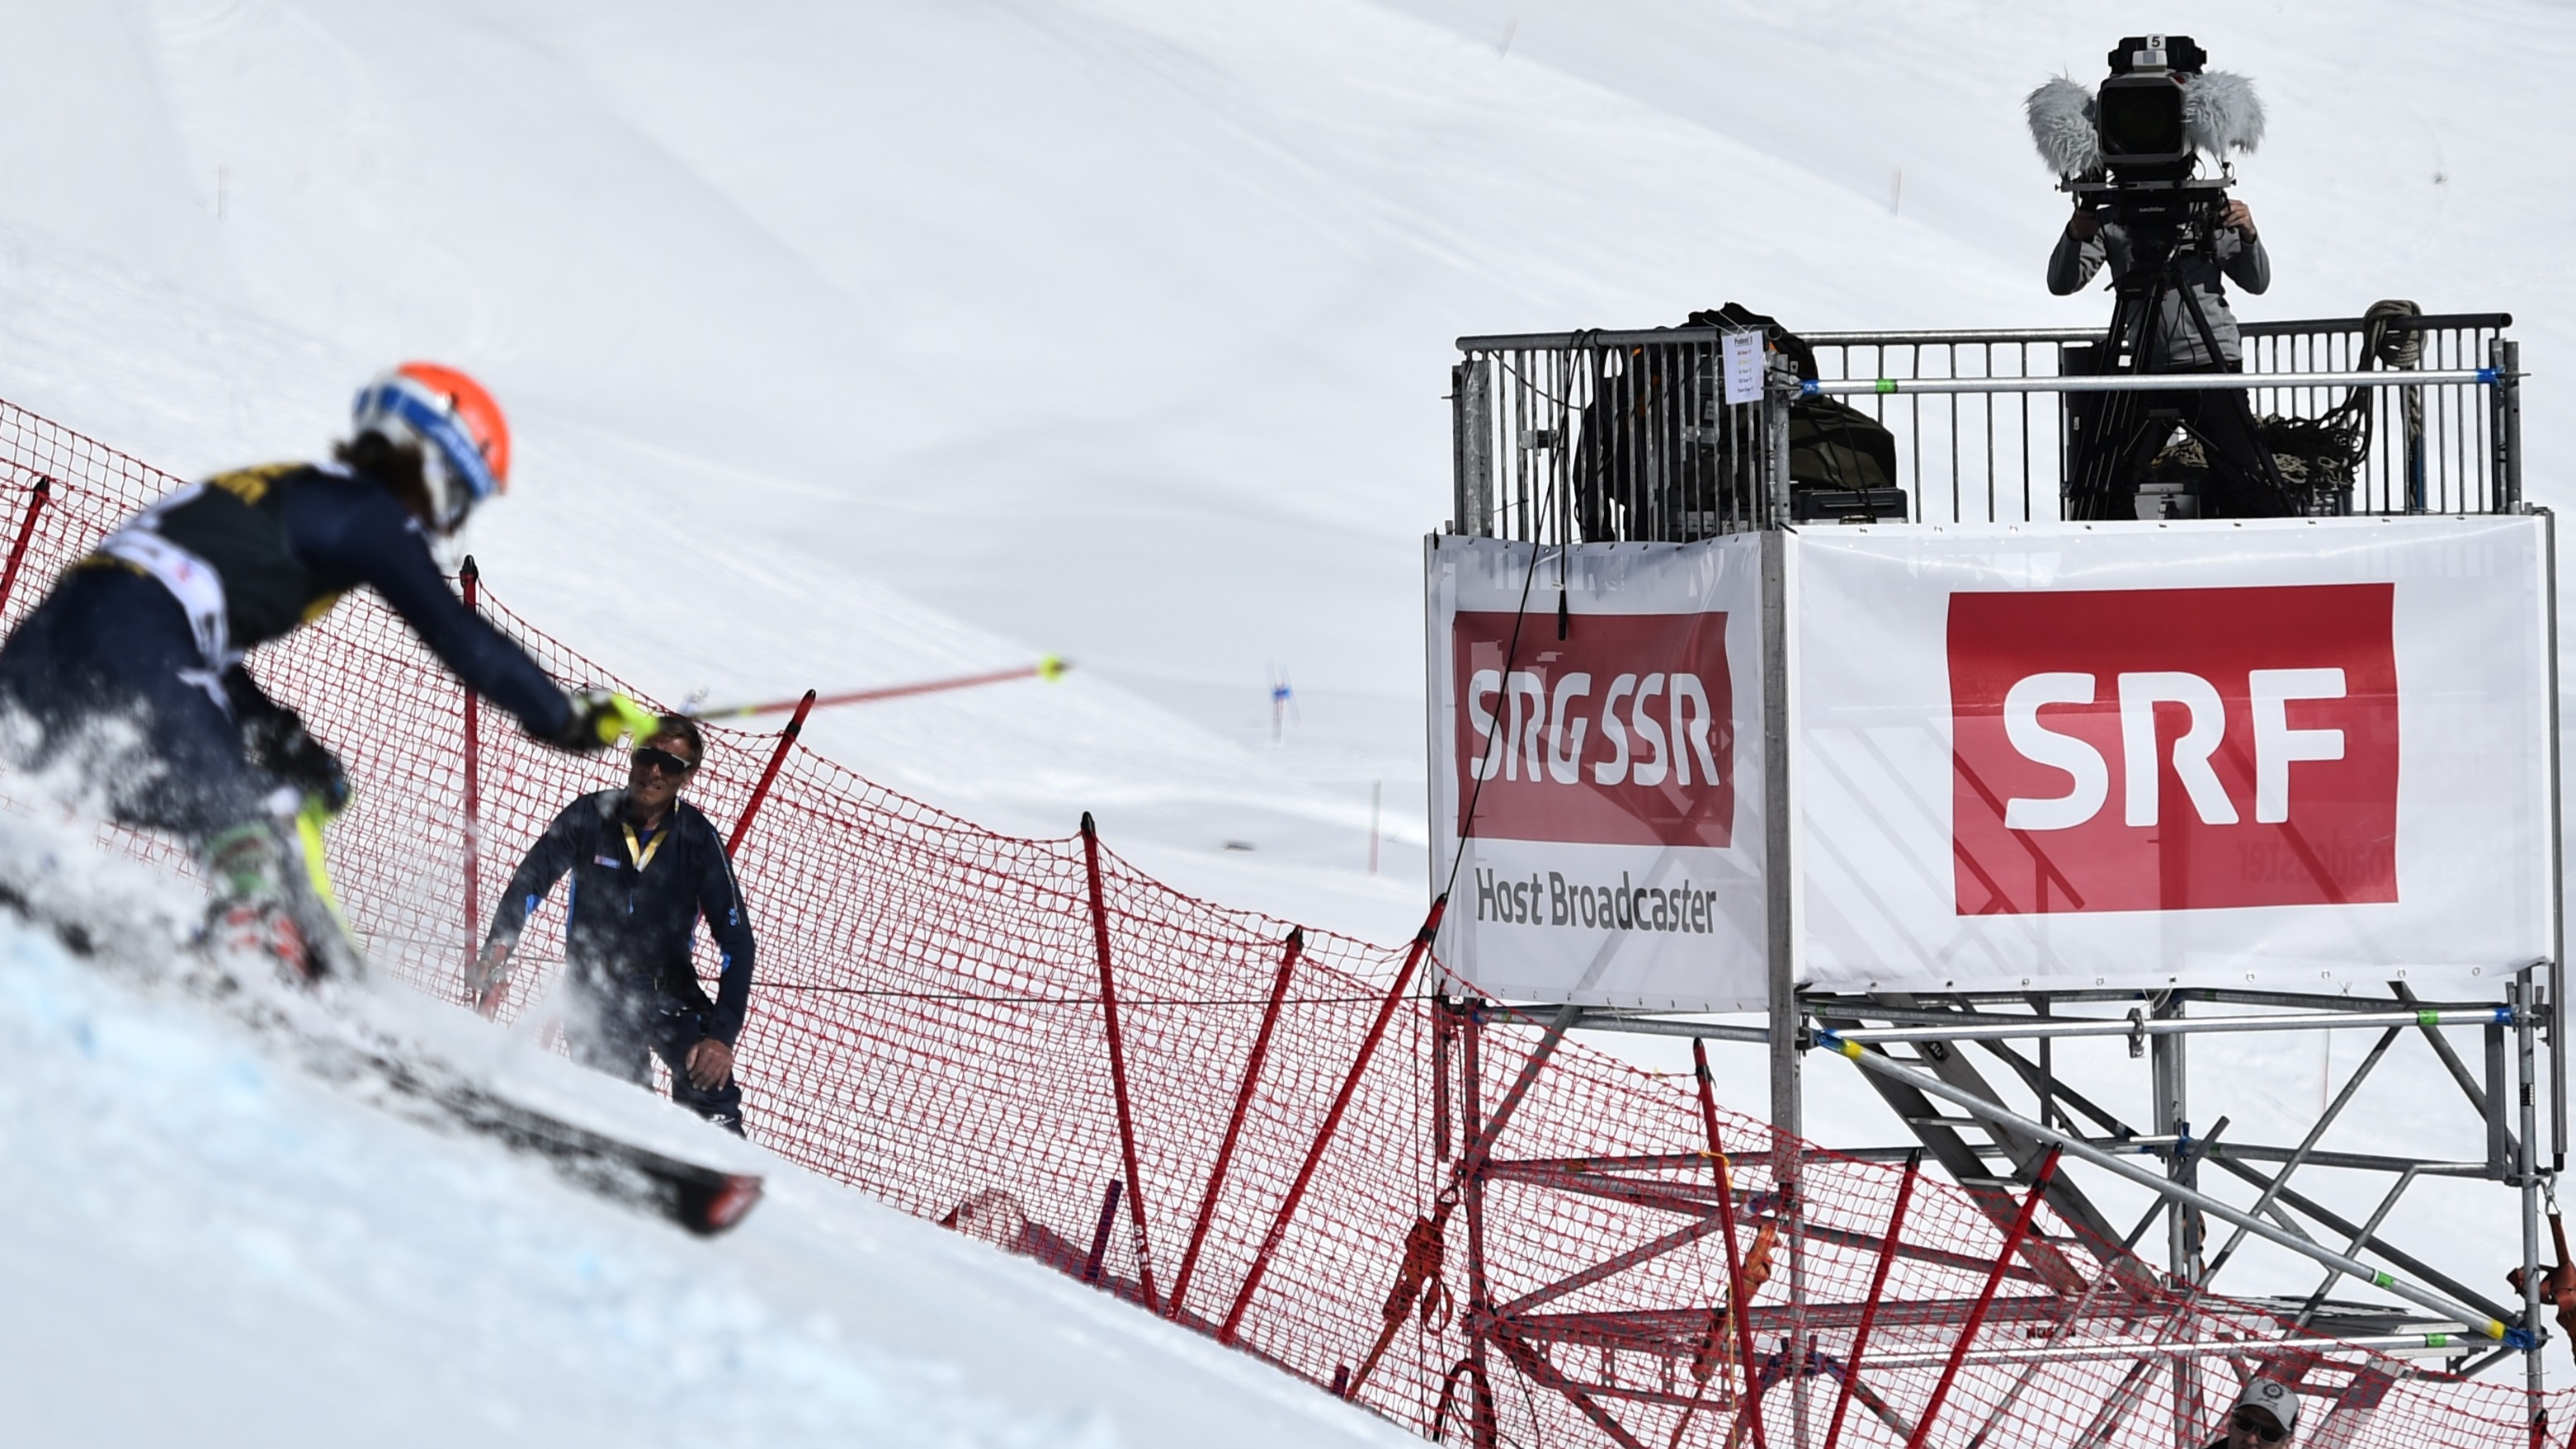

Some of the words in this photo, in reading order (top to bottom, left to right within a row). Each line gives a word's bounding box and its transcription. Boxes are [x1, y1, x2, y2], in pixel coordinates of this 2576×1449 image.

[2151, 35, 2161, 48] 5
[1468, 668, 1592, 786] SRG
[1594, 673, 1720, 787] SSR
[2003, 667, 2347, 831] SRF
[1475, 866, 1543, 926] Host
[1549, 870, 1717, 934] Broadcaster
